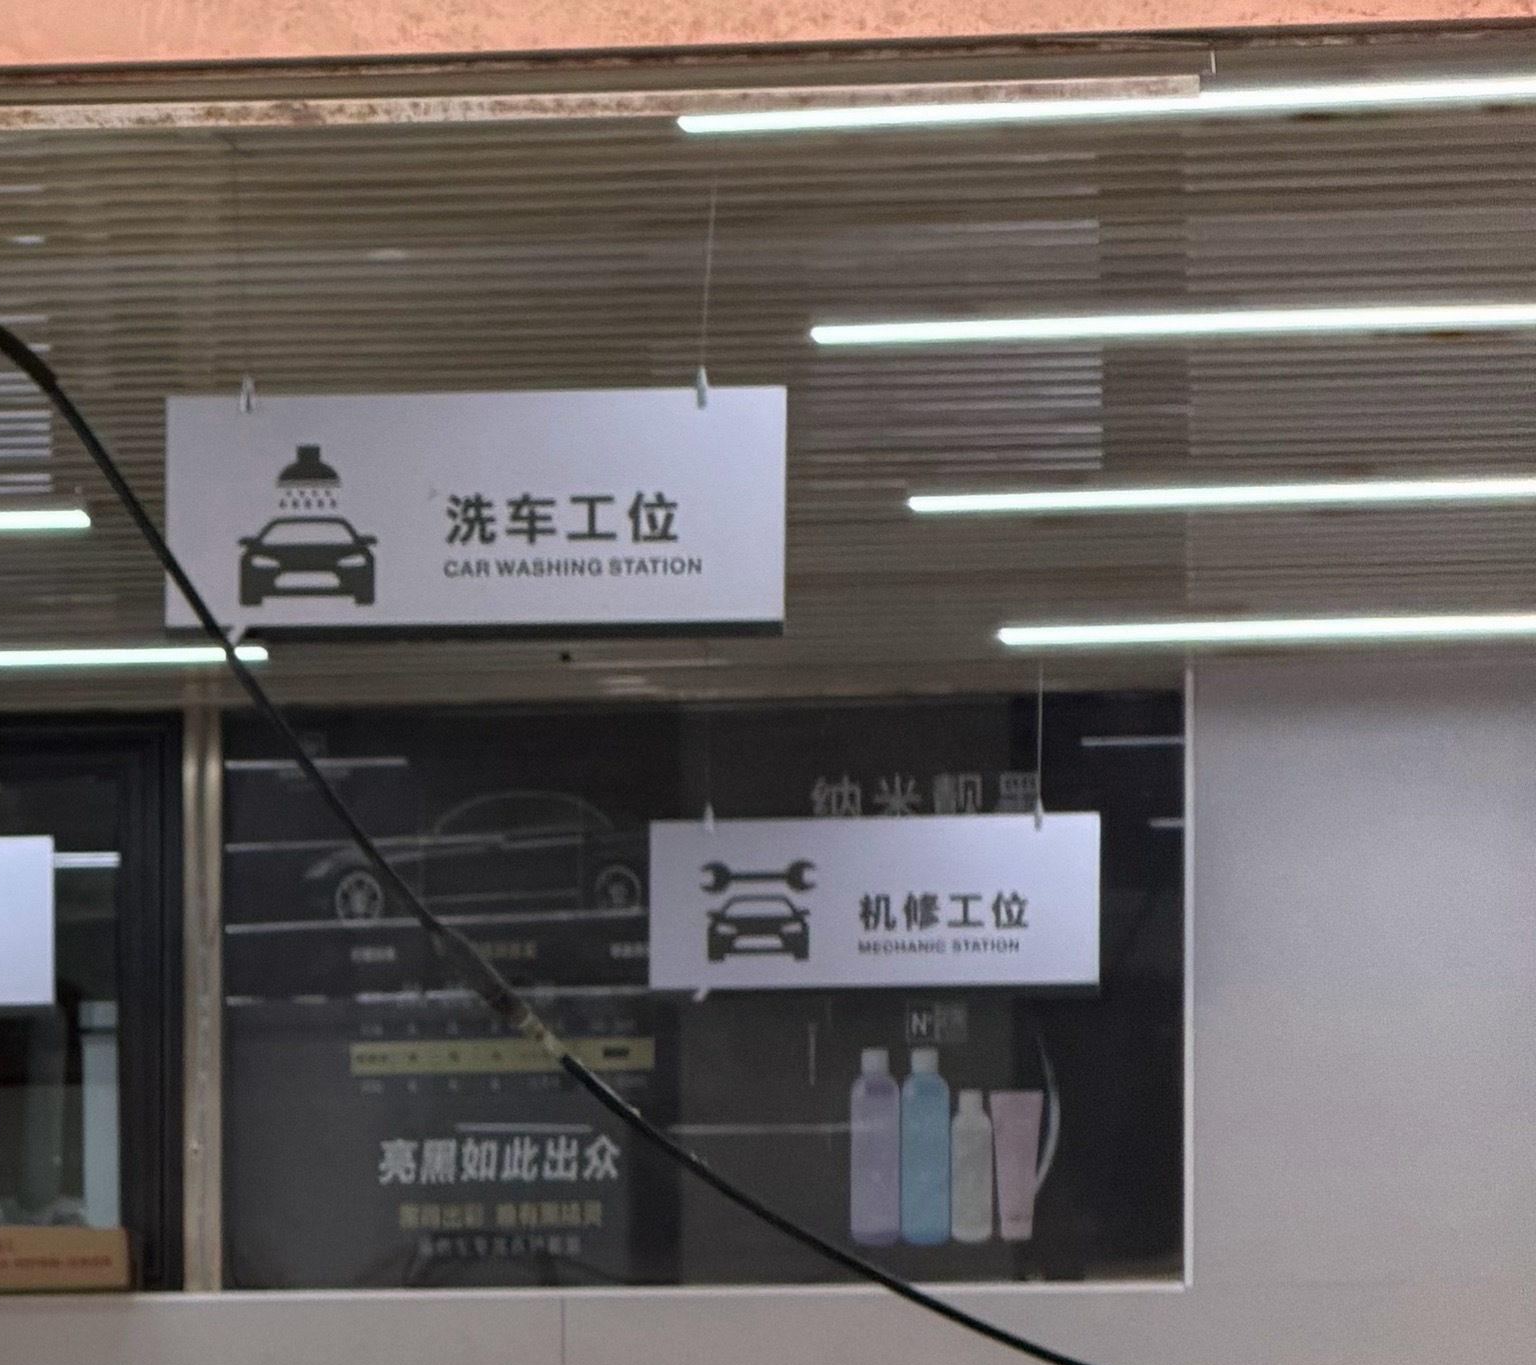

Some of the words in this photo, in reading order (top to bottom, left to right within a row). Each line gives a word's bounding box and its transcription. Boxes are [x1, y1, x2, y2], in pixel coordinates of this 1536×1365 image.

[445, 491, 678, 545] 洗车工位
[442, 558, 490, 579] CAR
[495, 557, 603, 578] WASHING
[608, 556, 703, 577] STATION
[858, 890, 1029, 932] 机修工位
[857, 938, 946, 955] MECHANIC
[951, 938, 1021, 955] STATION
[378, 1134, 620, 1185] 亮黑如此出众
